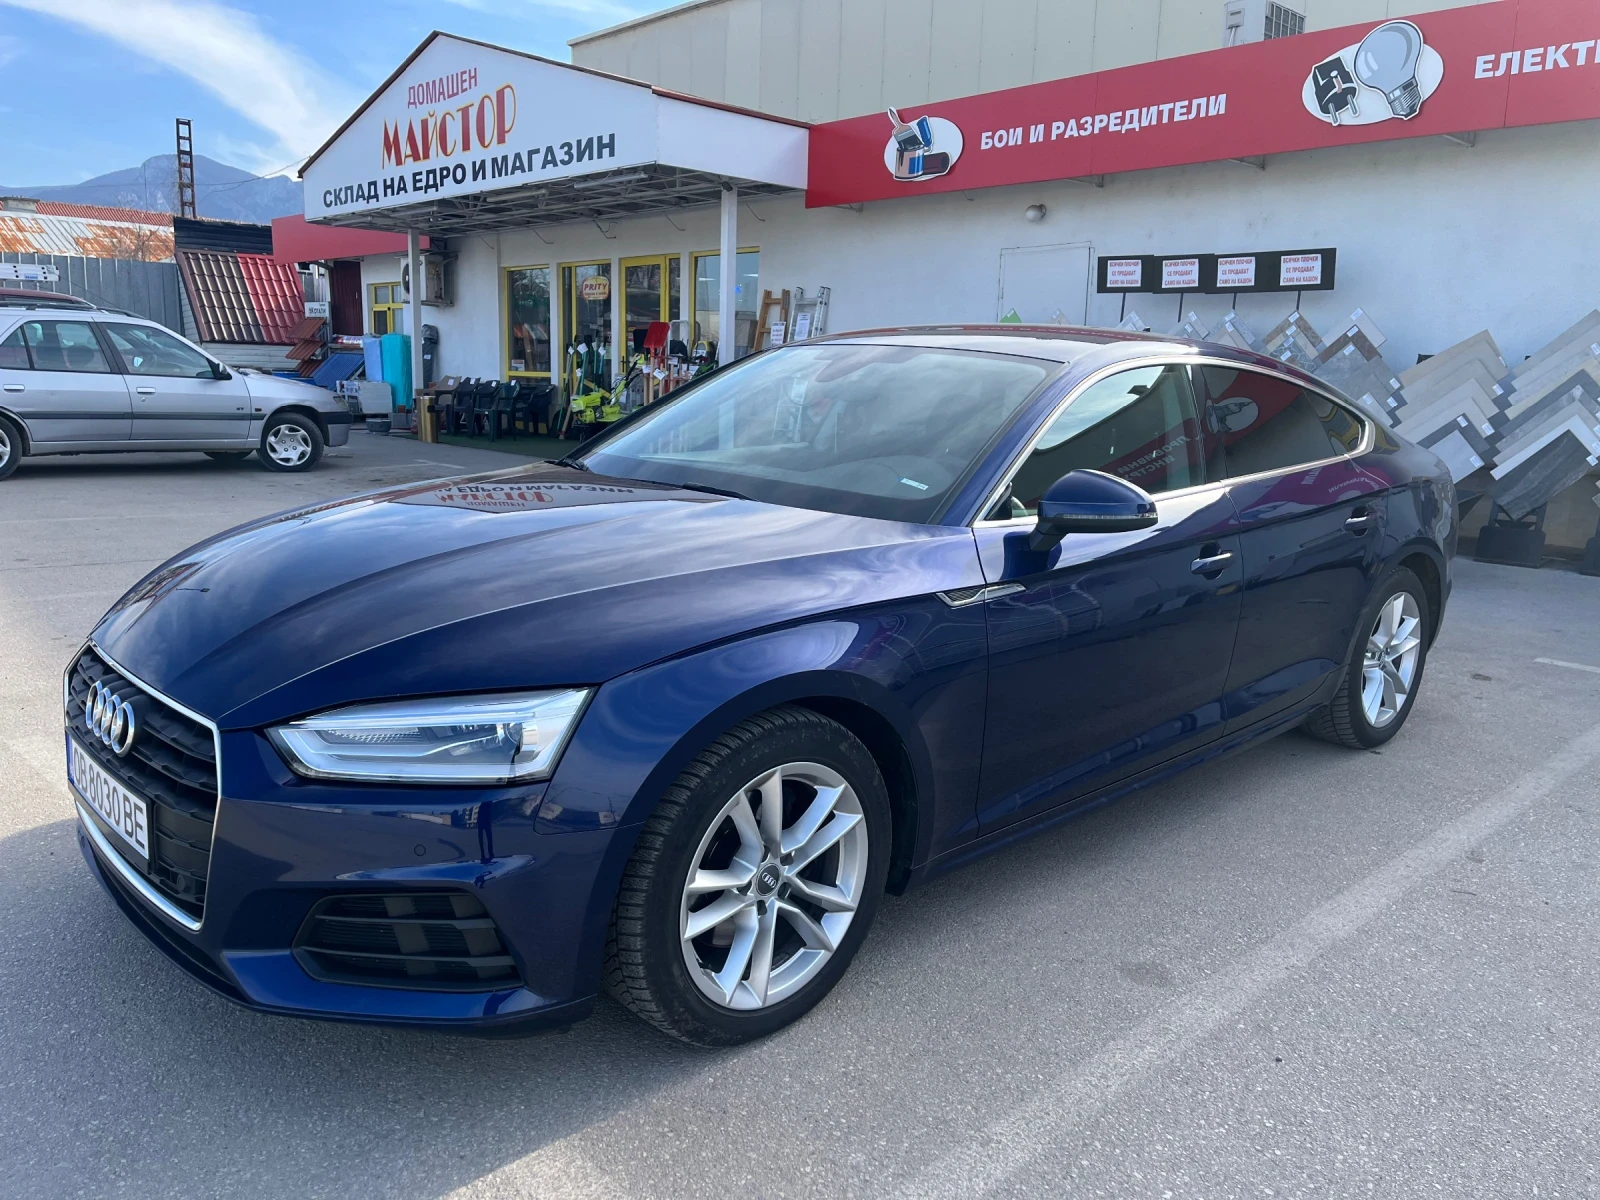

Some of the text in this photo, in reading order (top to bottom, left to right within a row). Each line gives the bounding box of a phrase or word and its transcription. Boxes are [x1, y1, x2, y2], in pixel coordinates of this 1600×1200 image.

[407, 67, 478, 109] ДОМАШЕН
[382, 82, 517, 170] МАЙСТОР
[980, 93, 1227, 150] БОИ И РАЗРЕДИТЕЛИ
[323, 132, 616, 208] СКЛАД НА ЕДРО И МАГАЗИН
[584, 282, 608, 291] PRITY
[88, 763, 121, 827] 8030
[122, 792, 146, 851] BE
